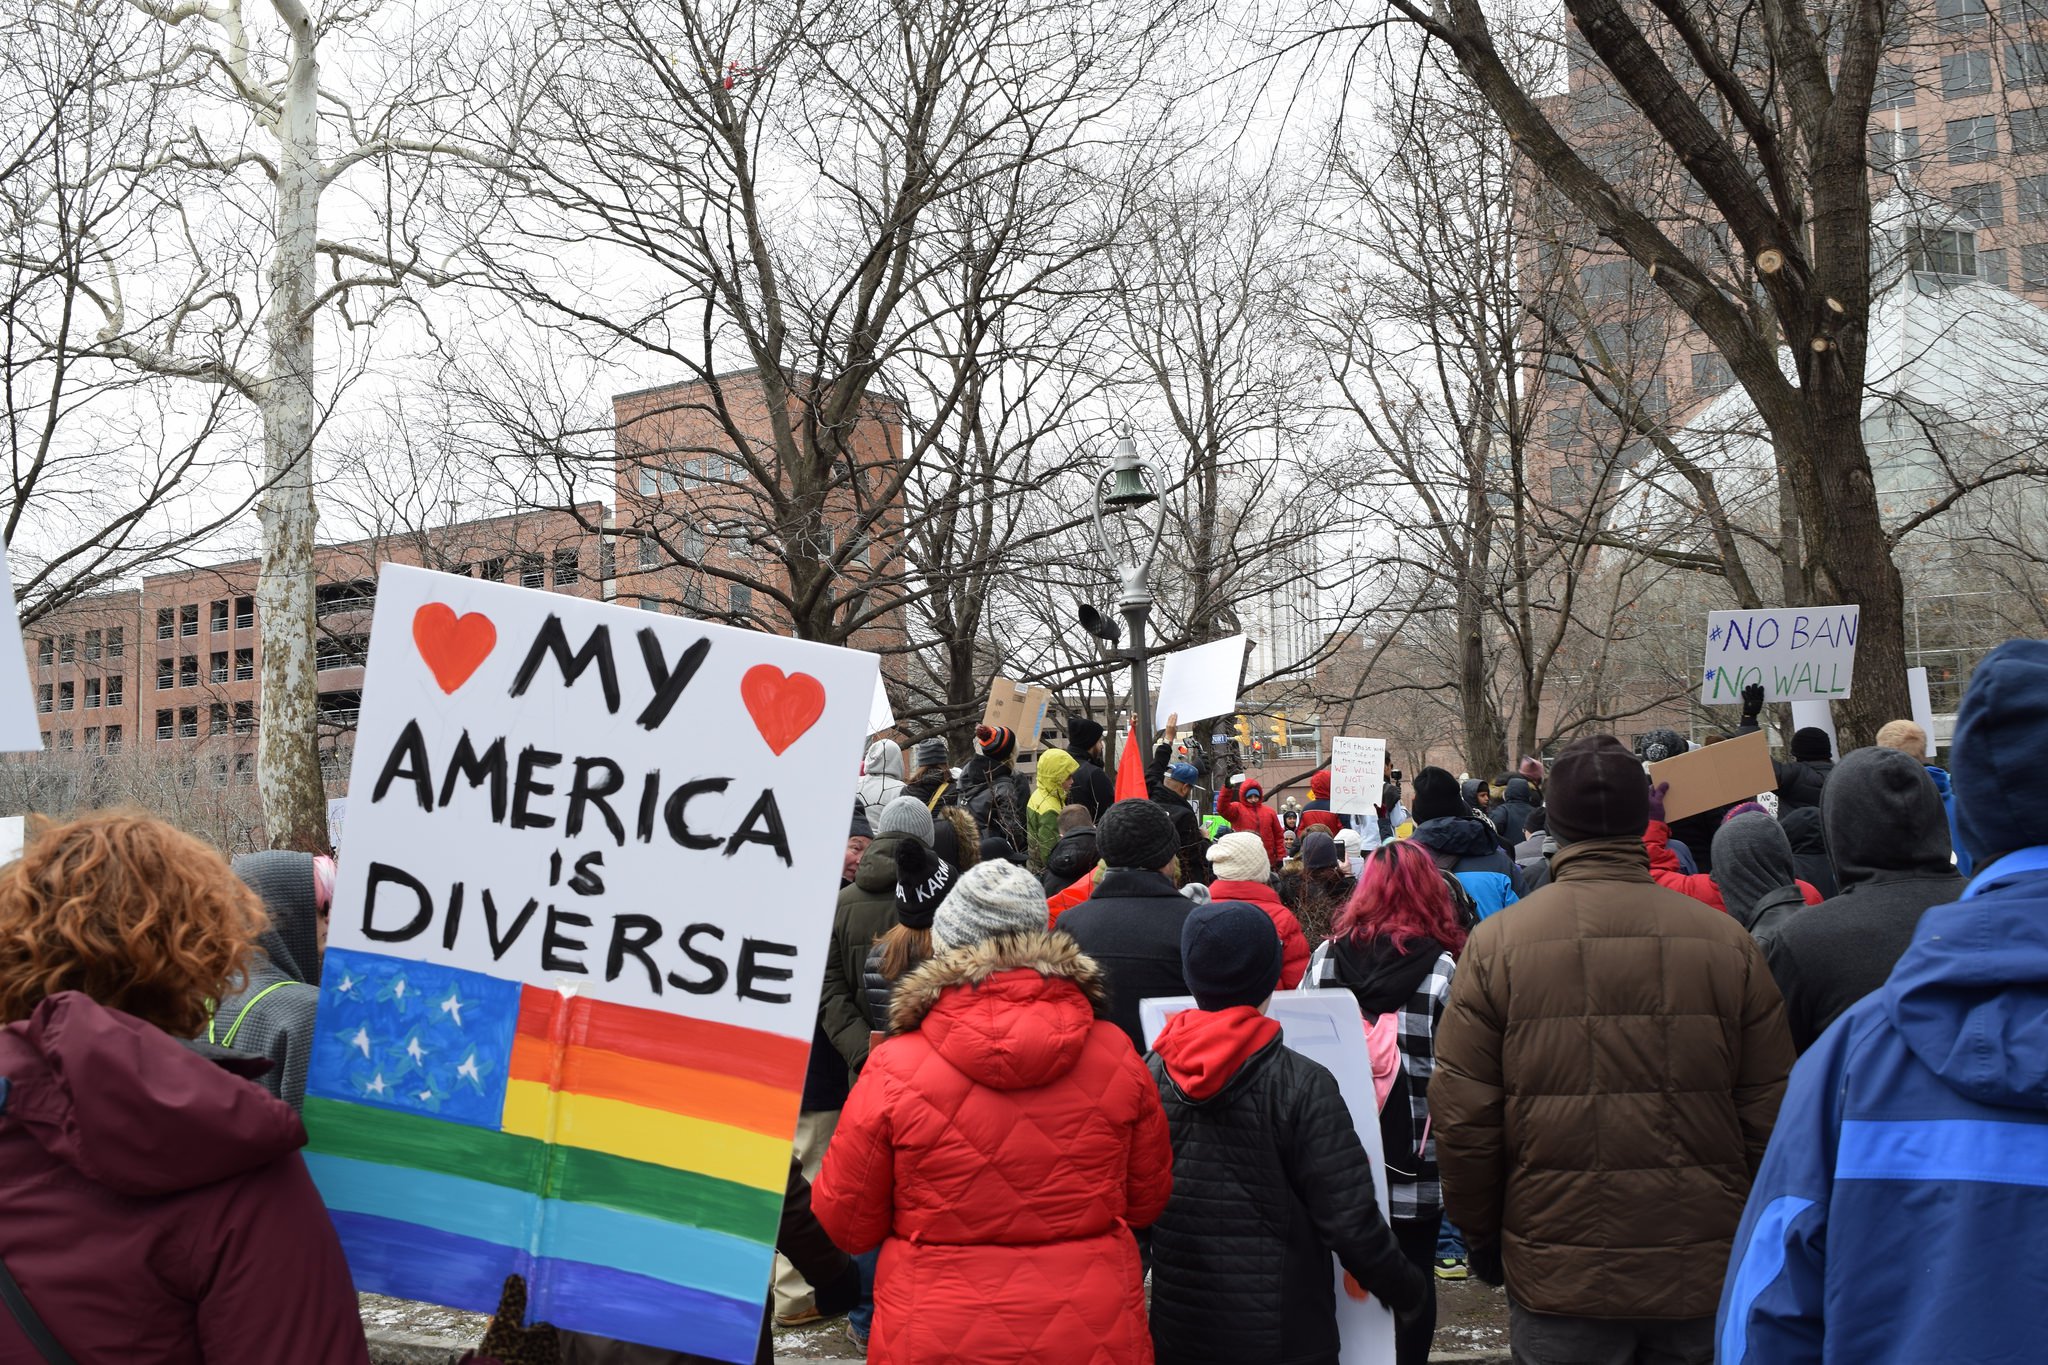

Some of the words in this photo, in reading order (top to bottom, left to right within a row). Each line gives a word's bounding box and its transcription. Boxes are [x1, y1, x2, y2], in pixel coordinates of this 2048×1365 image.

[1791, 613, 1857, 650] BAN
[508, 612, 714, 731] MY
[1774, 662, 1845, 697] WALL
[1334, 765, 1348, 774] WE
[1354, 766, 1376, 775] WILL
[1344, 775, 1364, 783] NOT
[371, 717, 793, 868] AMERICA
[361, 861, 797, 1003] DIVERSE
